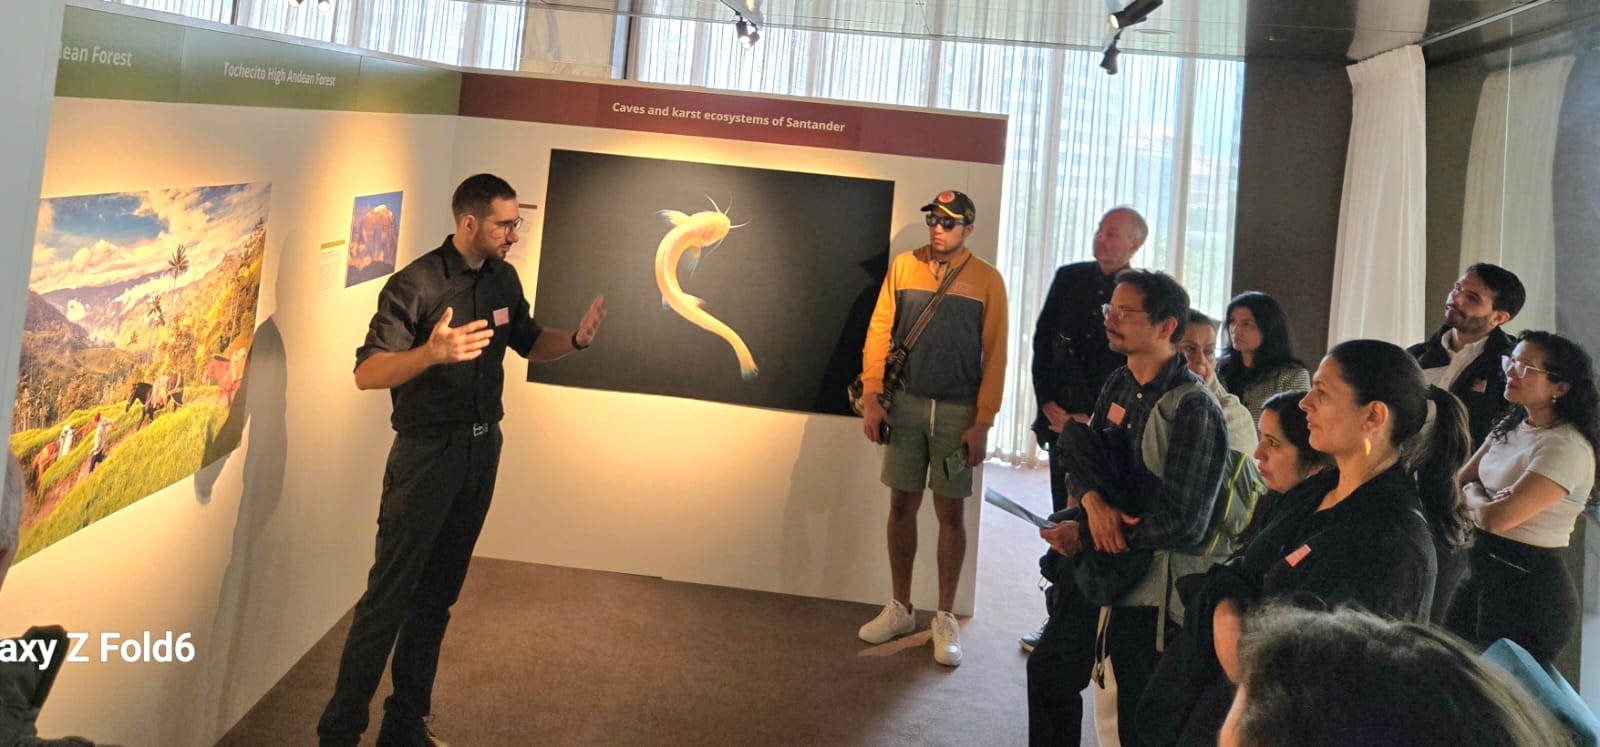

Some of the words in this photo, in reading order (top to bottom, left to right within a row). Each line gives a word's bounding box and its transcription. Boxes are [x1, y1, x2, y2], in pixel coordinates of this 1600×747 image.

[91, 45, 133, 67] Forest
[223, 62, 267, 81] Tochecito
[267, 67, 286, 86] High
[286, 69, 315, 85] Andean
[315, 72, 337, 88] Forest
[612, 102, 646, 114] Caves
[647, 106, 669, 117] and
[672, 107, 702, 120] karst
[704, 111, 769, 126] ecosystems
[772, 116, 785, 127] of
[786, 117, 846, 132] Santander
